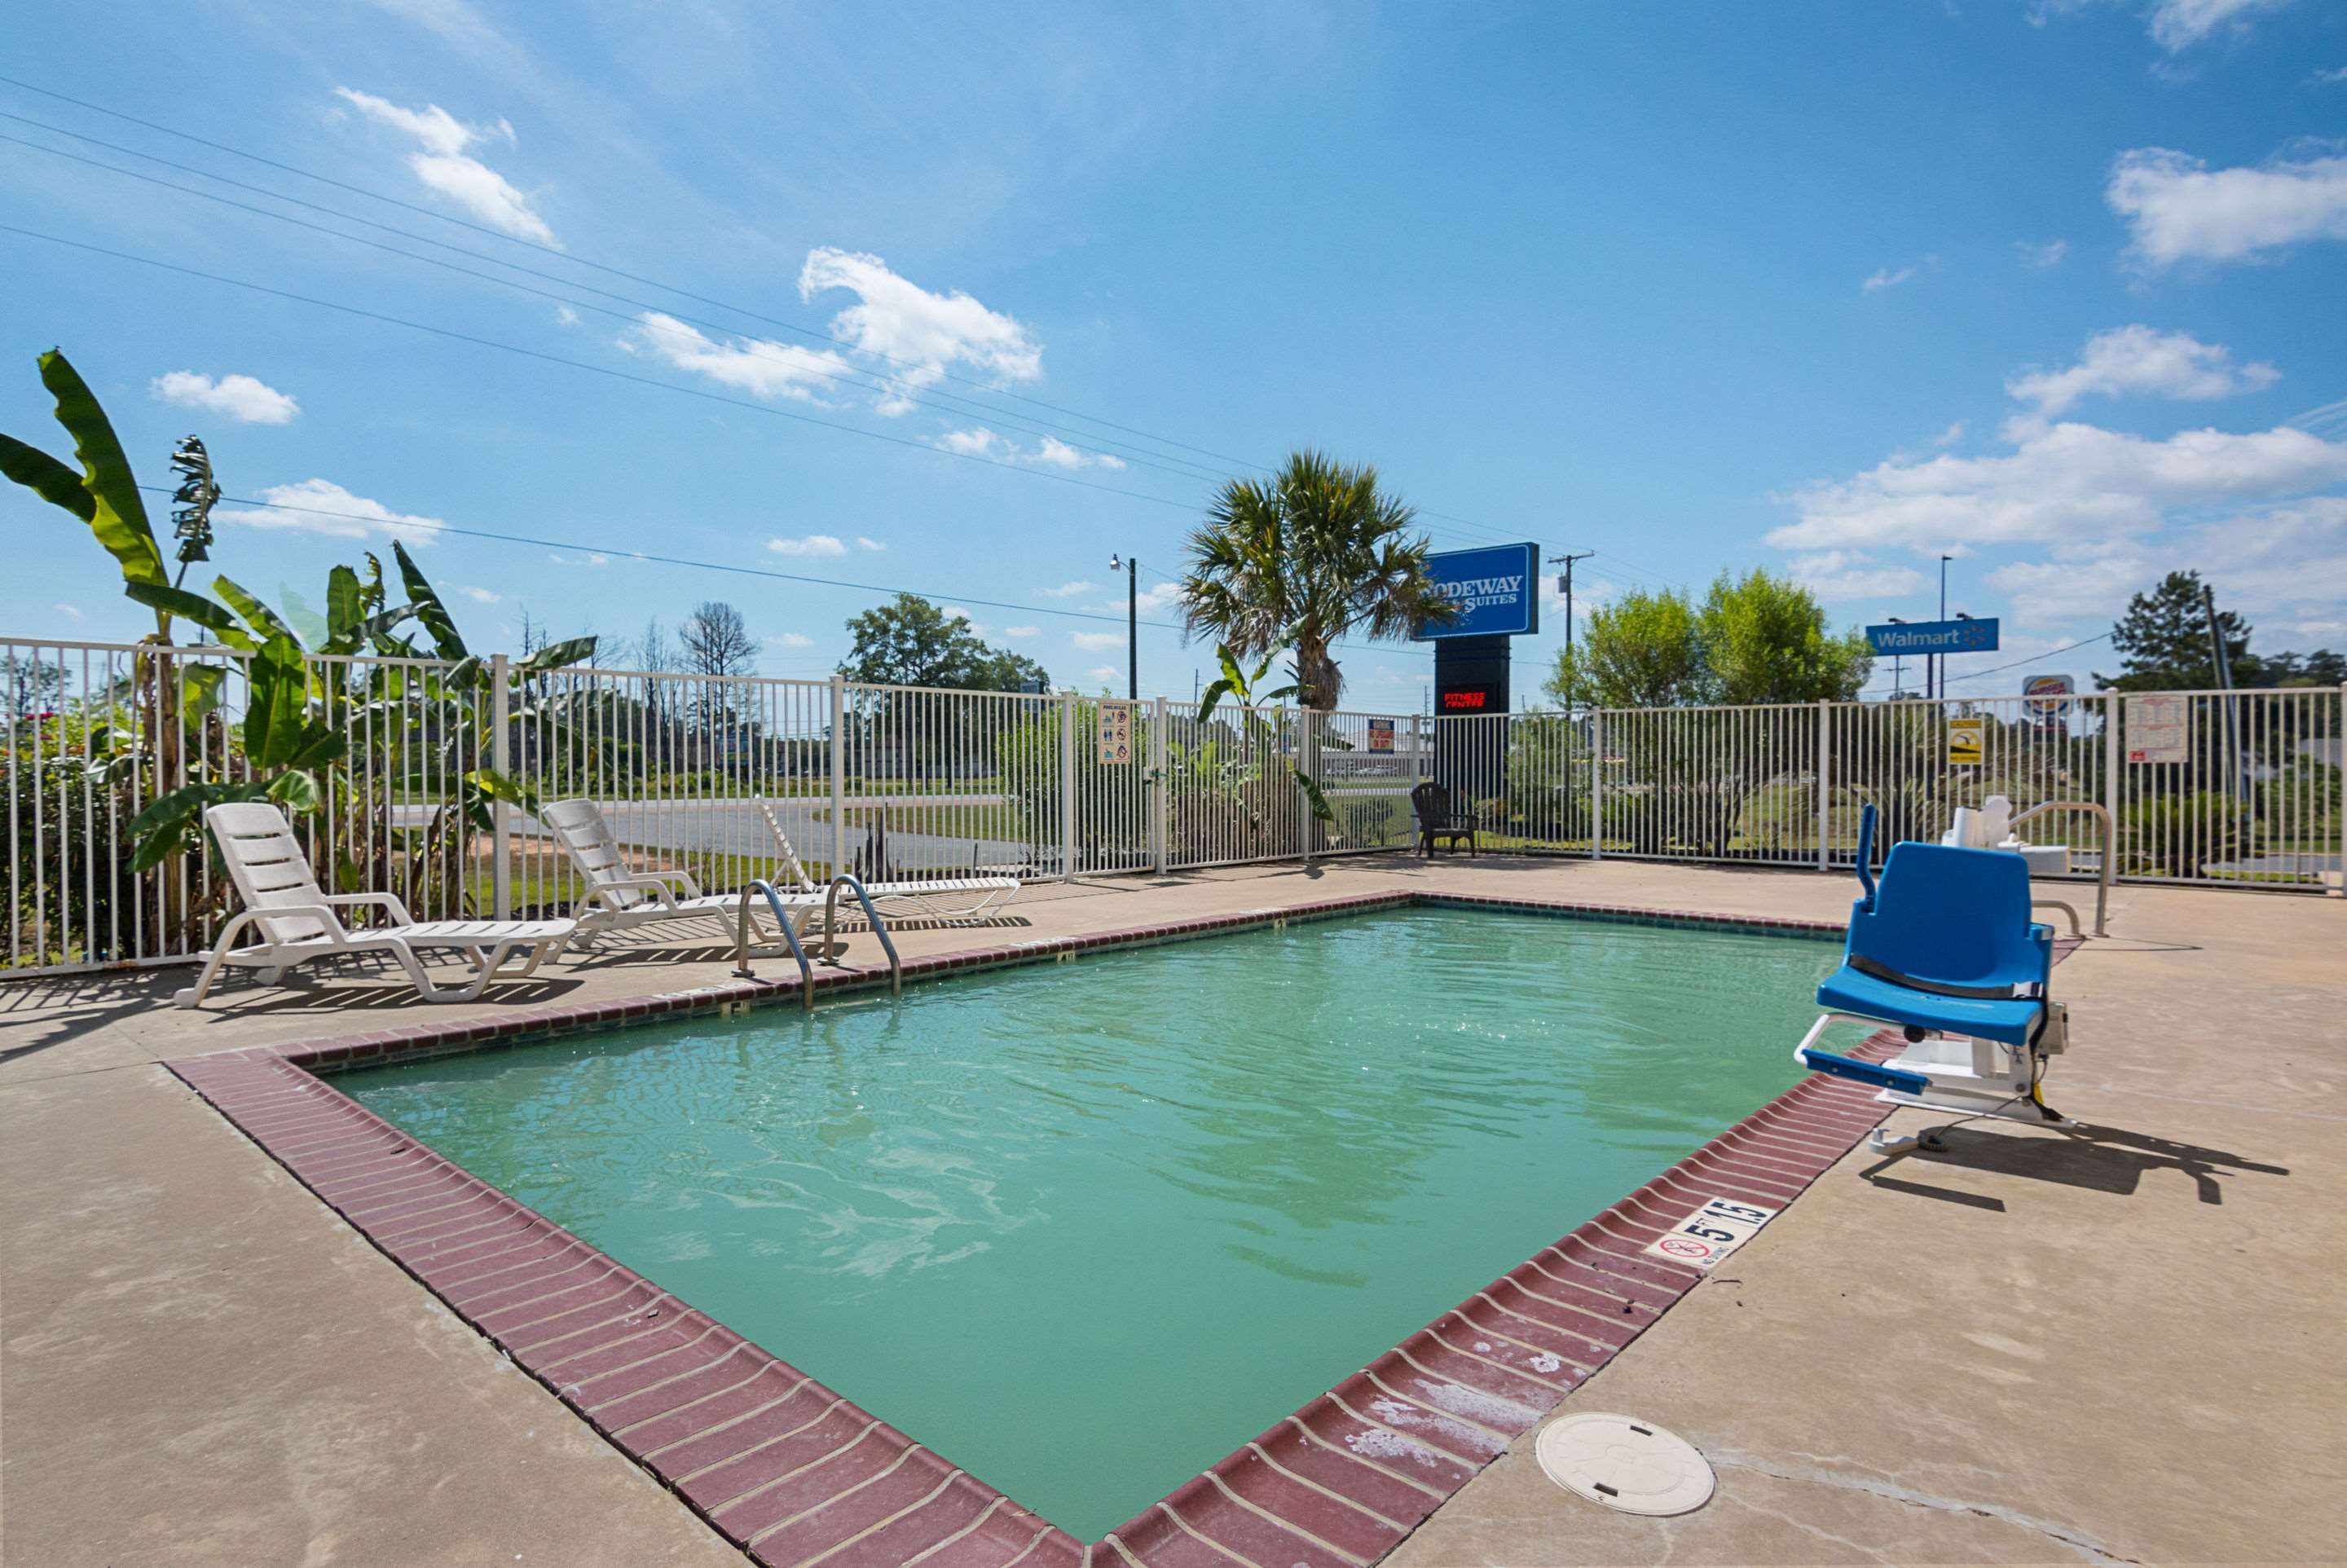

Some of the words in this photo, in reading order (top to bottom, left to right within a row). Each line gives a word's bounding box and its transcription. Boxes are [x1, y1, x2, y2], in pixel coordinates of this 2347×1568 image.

[1464, 593, 1517, 613] SUITES
[1878, 628, 1960, 648] Walmart
[1444, 692, 1486, 702] FITNESS
[1684, 1224, 1735, 1242] 5
